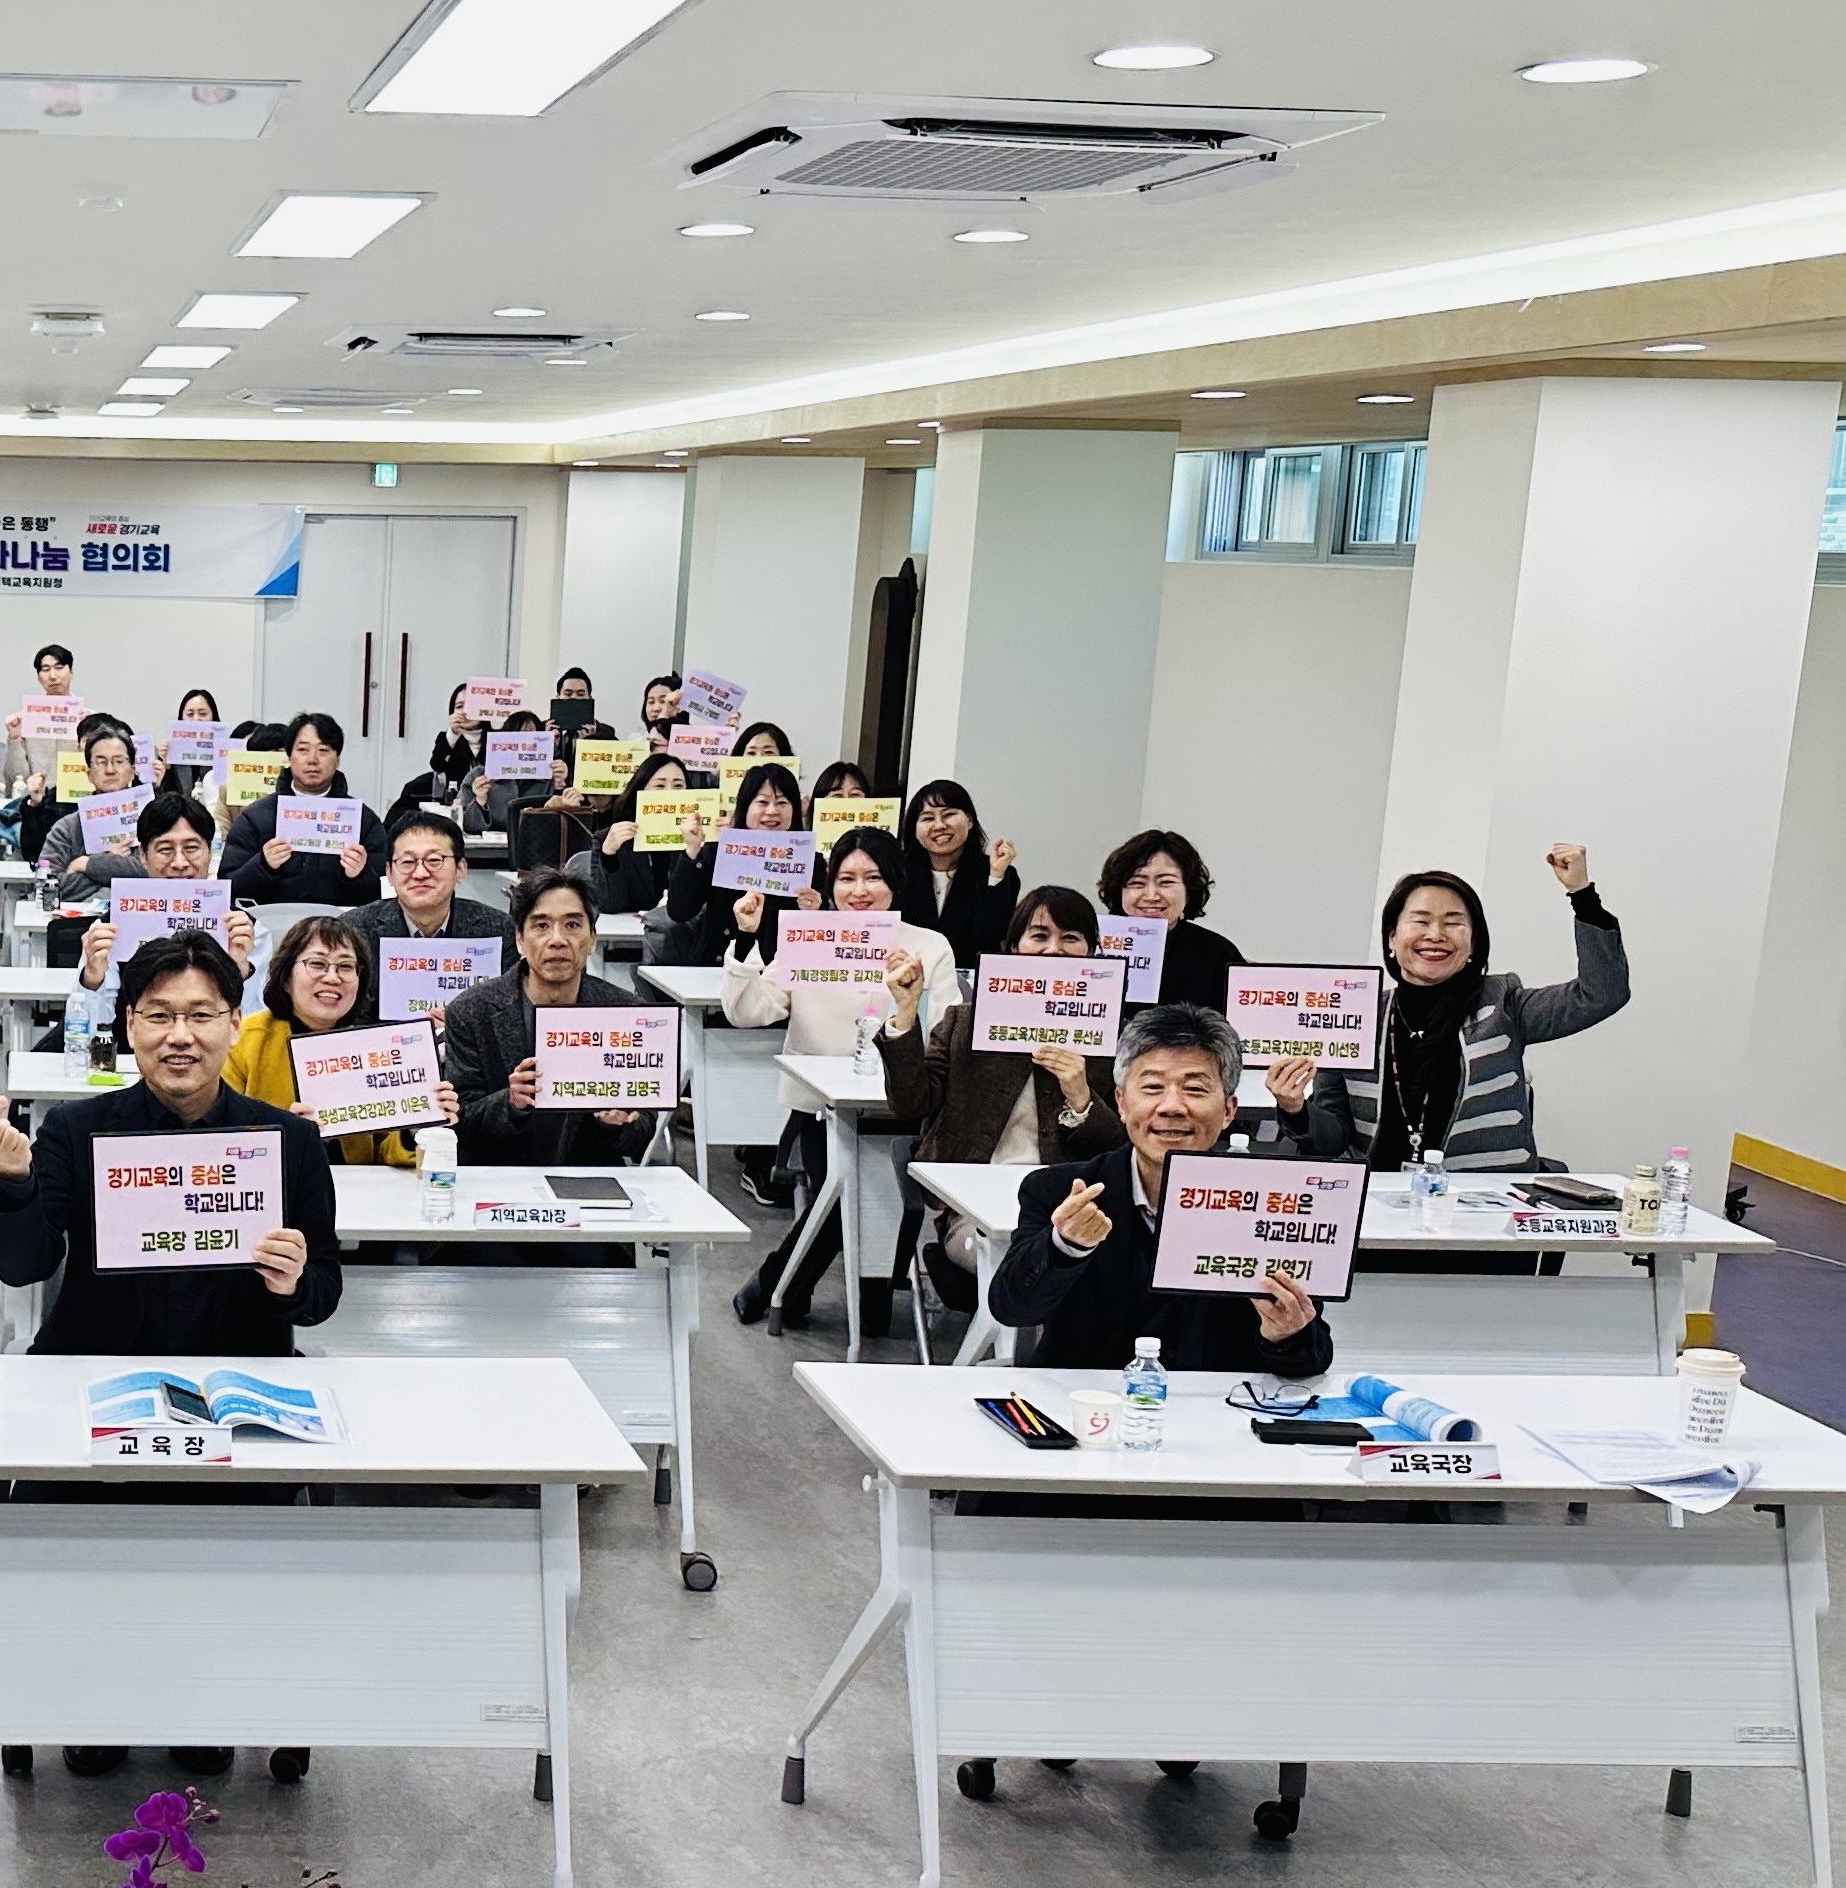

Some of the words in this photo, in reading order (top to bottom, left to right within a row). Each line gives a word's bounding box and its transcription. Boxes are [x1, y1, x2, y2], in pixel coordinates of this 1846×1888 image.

[119, 524, 160, 535] 경기교육
[81, 542, 170, 572] 협의회
[85, 806, 118, 819] 경기교육의
[283, 809, 317, 820] 경기교육의
[321, 810, 341, 821] 중심은
[820, 812, 855, 822] 경기교육의
[725, 844, 766, 858] 경기교육의
[770, 847, 793, 859] 중심은
[119, 898, 167, 912] 경기교육의
[172, 899, 202, 913] 중심은
[167, 917, 218, 931] 학교입니다!
[787, 930, 835, 942] 경기교육의
[841, 930, 870, 943] 중심은
[1103, 935, 1134, 951] 중심은
[388, 958, 437, 971] 경기교육의
[443, 958, 472, 972] 중심은
[791, 970, 849, 982] 기획경영팀장
[854, 970, 883, 983] 김지원
[989, 978, 1046, 995] 경기교육의
[1052, 980, 1088, 997] 중심은
[1238, 990, 1298, 1007] 경기교육의
[1305, 992, 1341, 1008] 중심은
[1045, 1001, 1107, 1019] 학교입니다!
[1297, 1012, 1362, 1030] 학교입니다!
[546, 1032, 603, 1047] 경기교육의
[609, 1031, 643, 1047] 중심은
[988, 1025, 1069, 1044] 중등교육지원과장
[1241, 1039, 1323, 1057] 초등교육지원과장
[305, 1055, 363, 1077] 경기교육의
[367, 1049, 402, 1068] 중심은
[603, 1053, 664, 1068] 학교입니다!
[366, 1068, 426, 1089] 학교입니다!
[553, 1081, 621, 1097] 지역교육과장
[318, 1100, 396, 1125] 평생교육건강과장
[107, 1166, 183, 1189] 경기교육의
[191, 1164, 236, 1186] 중심은
[184, 1191, 264, 1214] 학교입니다!
[1180, 1188, 1258, 1212] 경기교육의
[1266, 1192, 1313, 1215] 중심은
[1640, 1199, 1660, 1210] TO
[491, 1208, 566, 1223] 지역교육과장
[1254, 1219, 1338, 1245] 학교입니다!
[1516, 1218, 1617, 1234] 초등교육지원과장
[141, 1231, 187, 1252] 교육장
[194, 1229, 239, 1250] 김윤기
[1194, 1255, 1258, 1278] 교육국장
[1389, 1454, 1472, 1473] 교육국장
